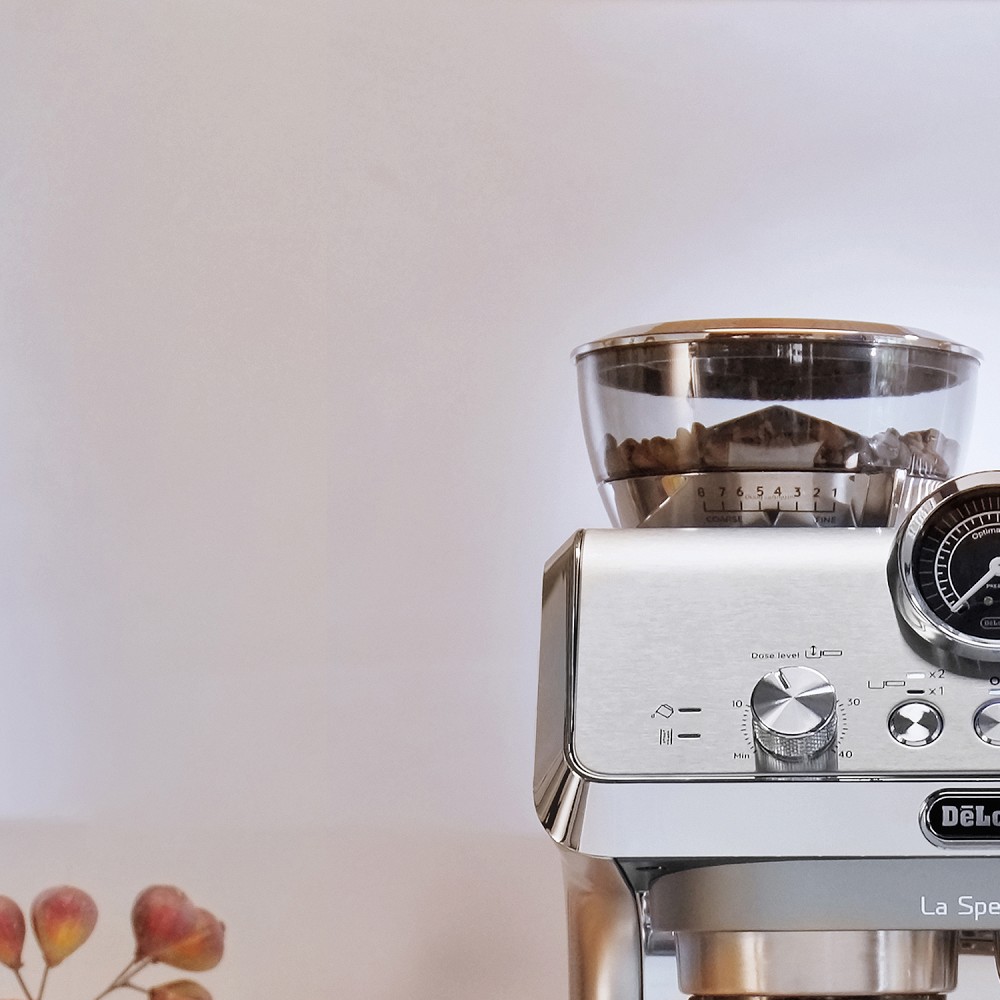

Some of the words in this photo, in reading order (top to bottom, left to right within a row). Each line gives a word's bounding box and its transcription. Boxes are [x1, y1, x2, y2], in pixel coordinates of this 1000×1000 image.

[719, 487, 725, 497] 7
[736, 487, 744, 497] 6
[756, 486, 764, 497] 5
[774, 486, 782, 497] 4
[793, 487, 801, 498] 3
[813, 487, 821, 498] 2
[751, 652, 774, 660] Dose
[777, 651, 800, 659] level
[732, 699, 743, 708] 10
[847, 698, 861, 706] 30
[838, 750, 853, 759] 40
[921, 896, 947, 915] La
